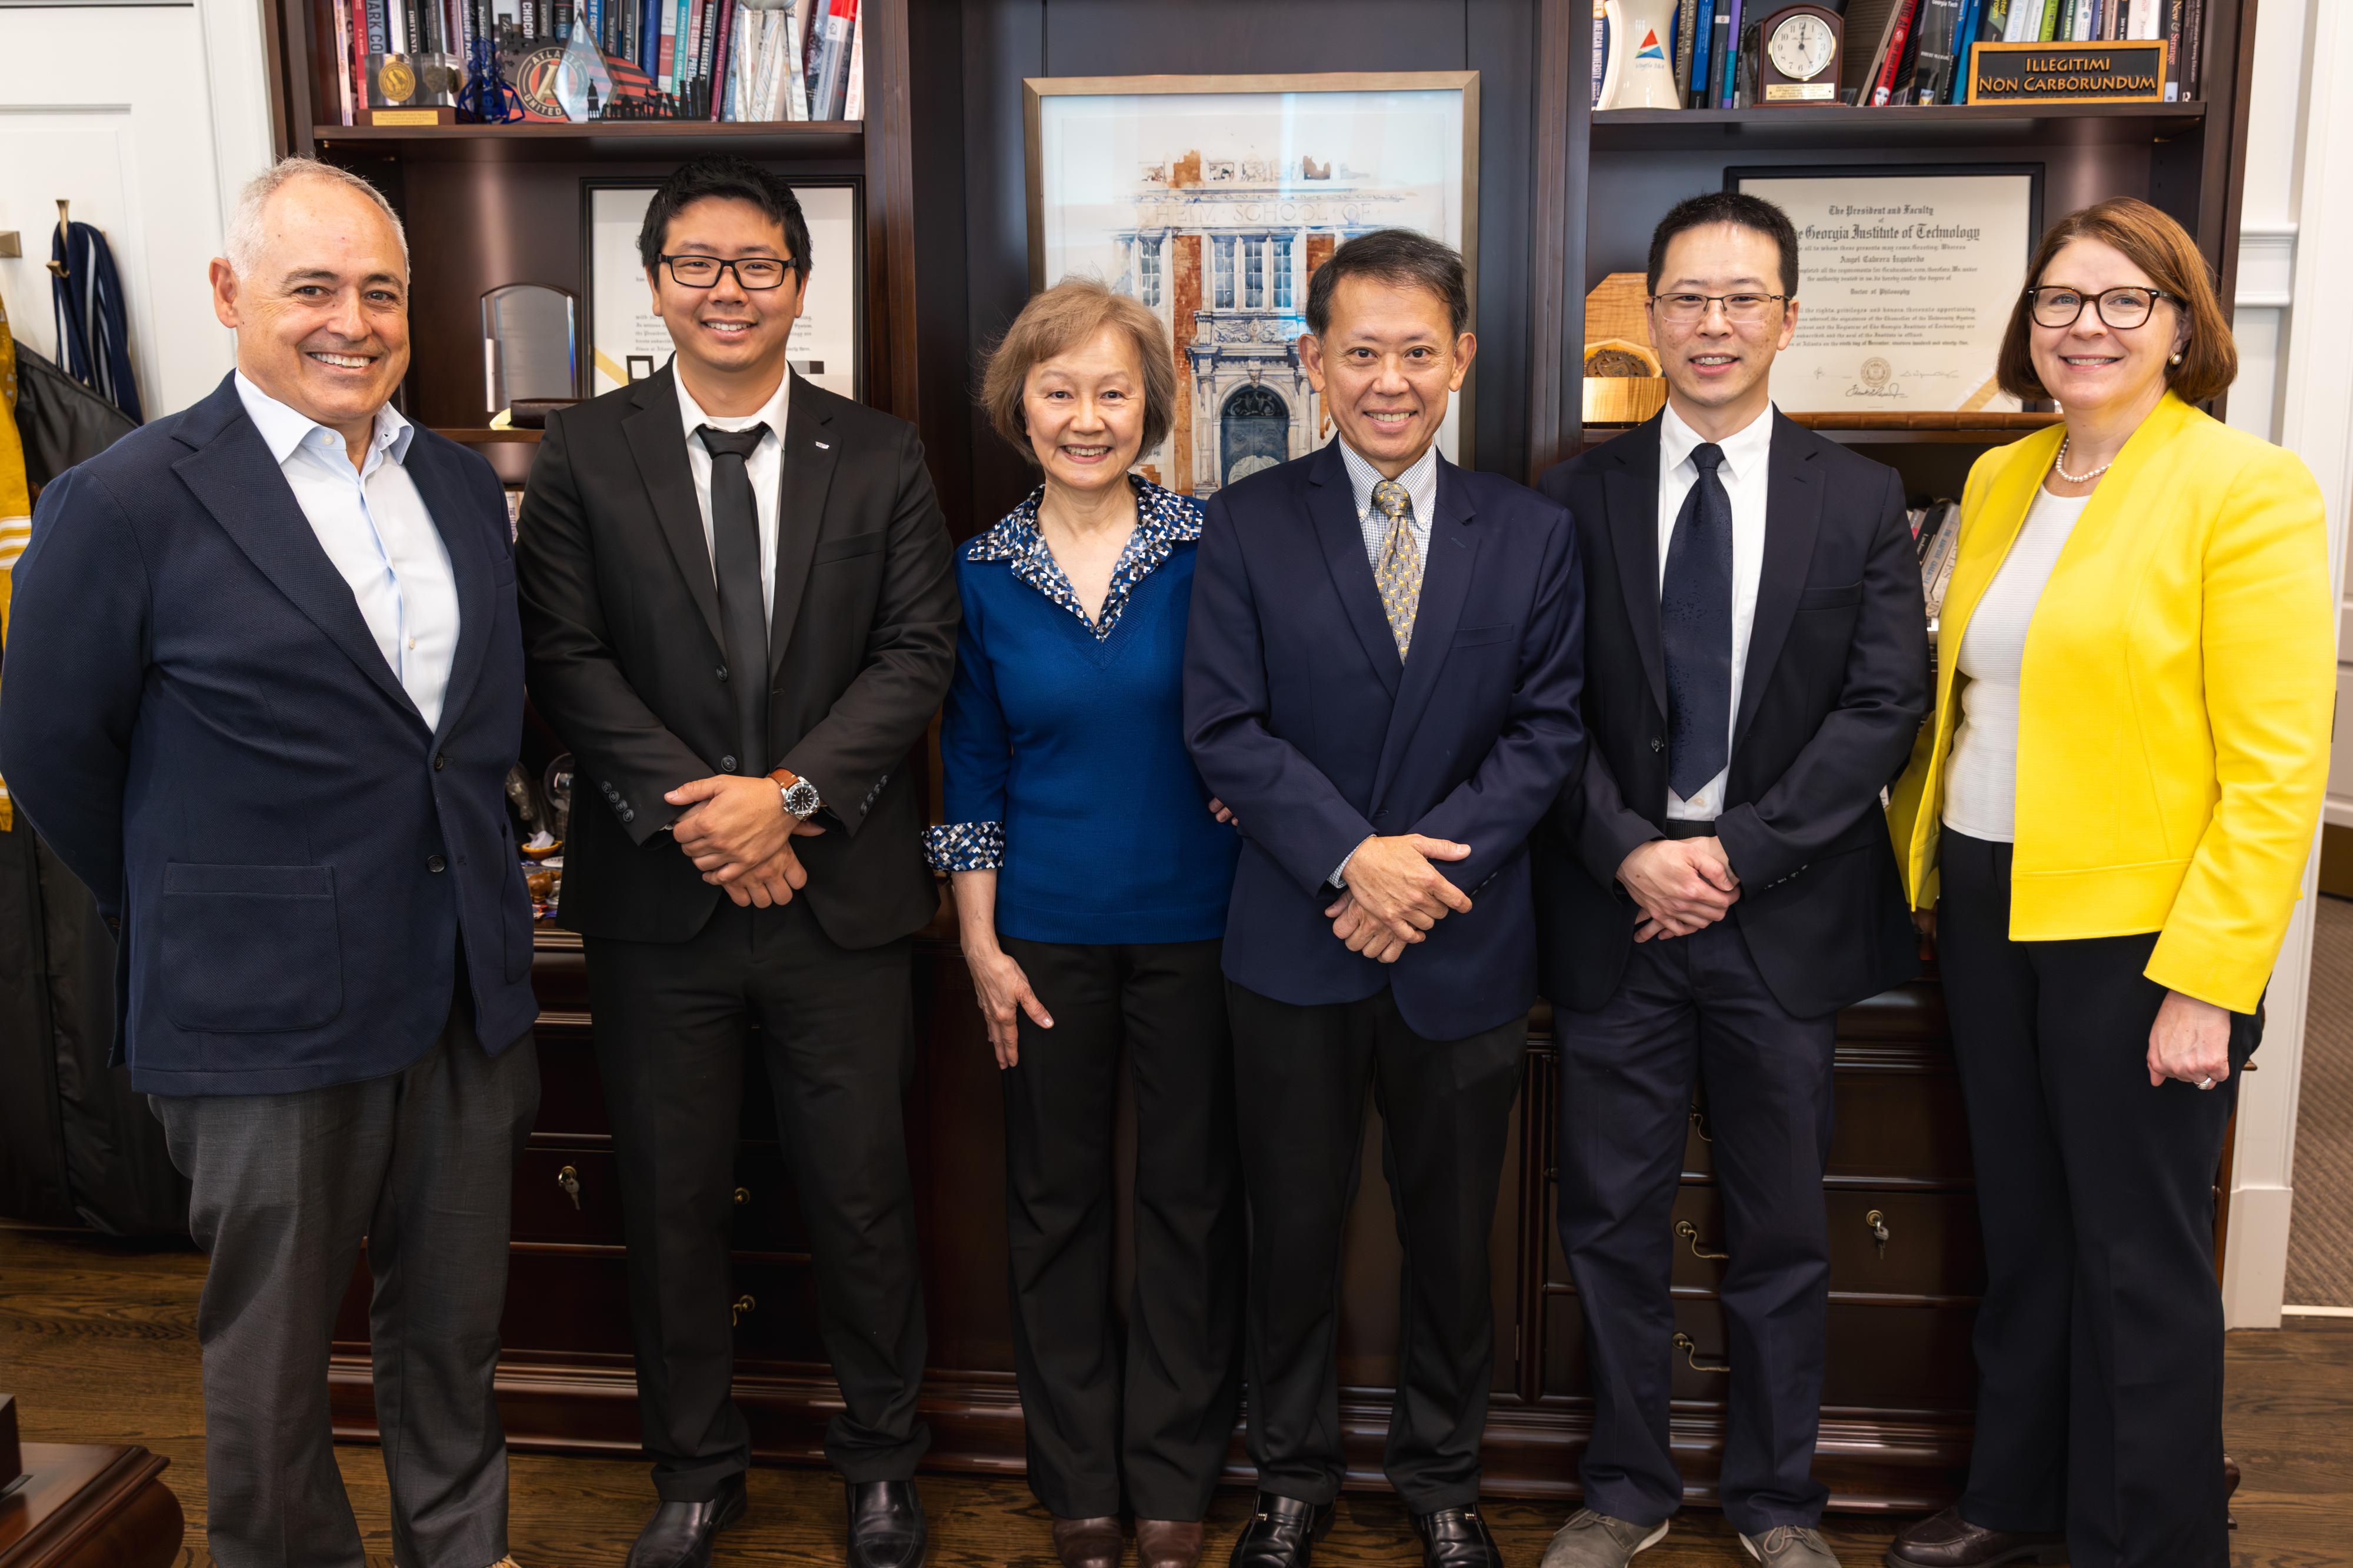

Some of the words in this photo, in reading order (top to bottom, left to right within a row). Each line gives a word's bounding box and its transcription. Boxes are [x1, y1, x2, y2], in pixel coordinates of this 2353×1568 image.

[1901, 0, 1915, 18] ING
[2172, 1, 2182, 21] New
[703, 4, 714, 37] BUSINESS
[1594, 19, 1604, 48] AMERICAN
[2167, 33, 2179, 65] Strange
[699, 38, 711, 81] RENAISSAN
[1592, 49, 1602, 79] UNIVERSITY
[2025, 58, 2111, 72] ILLEGITIMI
[1978, 76, 2018, 92] NON
[2023, 76, 2156, 92] CARBORUNDUM
[524, 94, 562, 116] UNITED
[1233, 203, 1328, 222] SCHOOL
[1342, 203, 1372, 222] OF
[1828, 205, 1844, 215] The
[1846, 205, 1886, 216] President
[1903, 204, 1934, 216] Faculty
[1805, 224, 1849, 242] Georgia
[1849, 223, 1899, 239] Institute
[1902, 224, 1915, 239] of
[1916, 223, 1980, 241] Technology
[1840, 255, 1860, 263] Angel
[1892, 255, 1925, 263] Izquierdo
